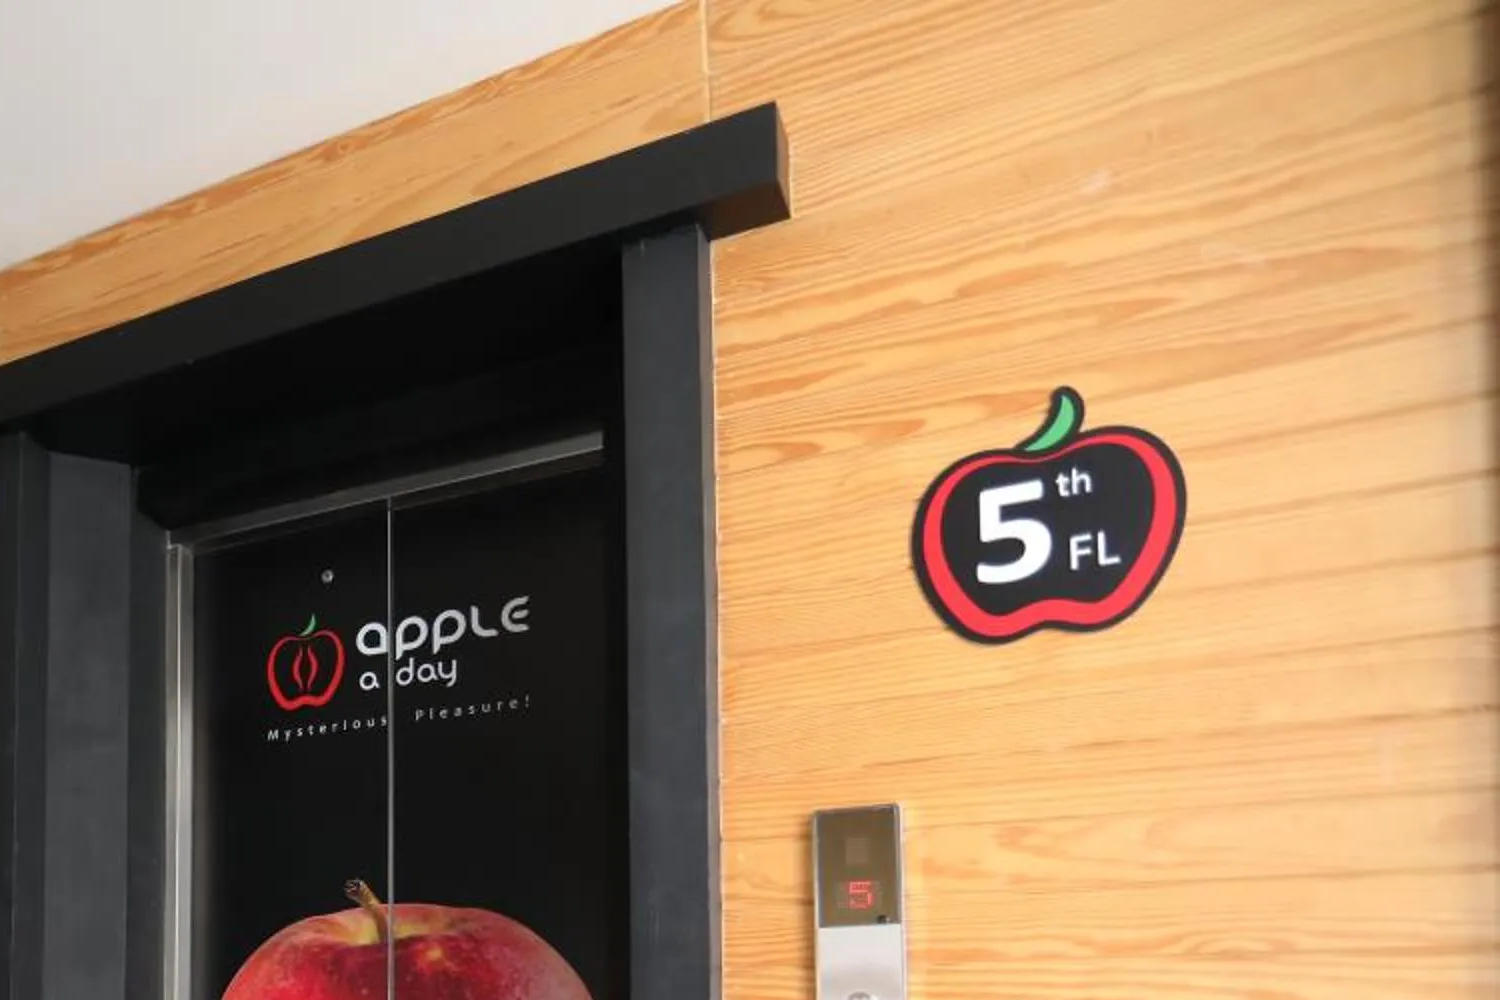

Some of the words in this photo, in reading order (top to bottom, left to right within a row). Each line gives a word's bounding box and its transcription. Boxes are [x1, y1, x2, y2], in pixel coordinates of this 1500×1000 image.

[1069, 529, 1122, 571] FL
[359, 671, 380, 691] a
[395, 657, 457, 687] day
[267, 716, 388, 743] Mysterious
[848, 880, 874, 909] 5
